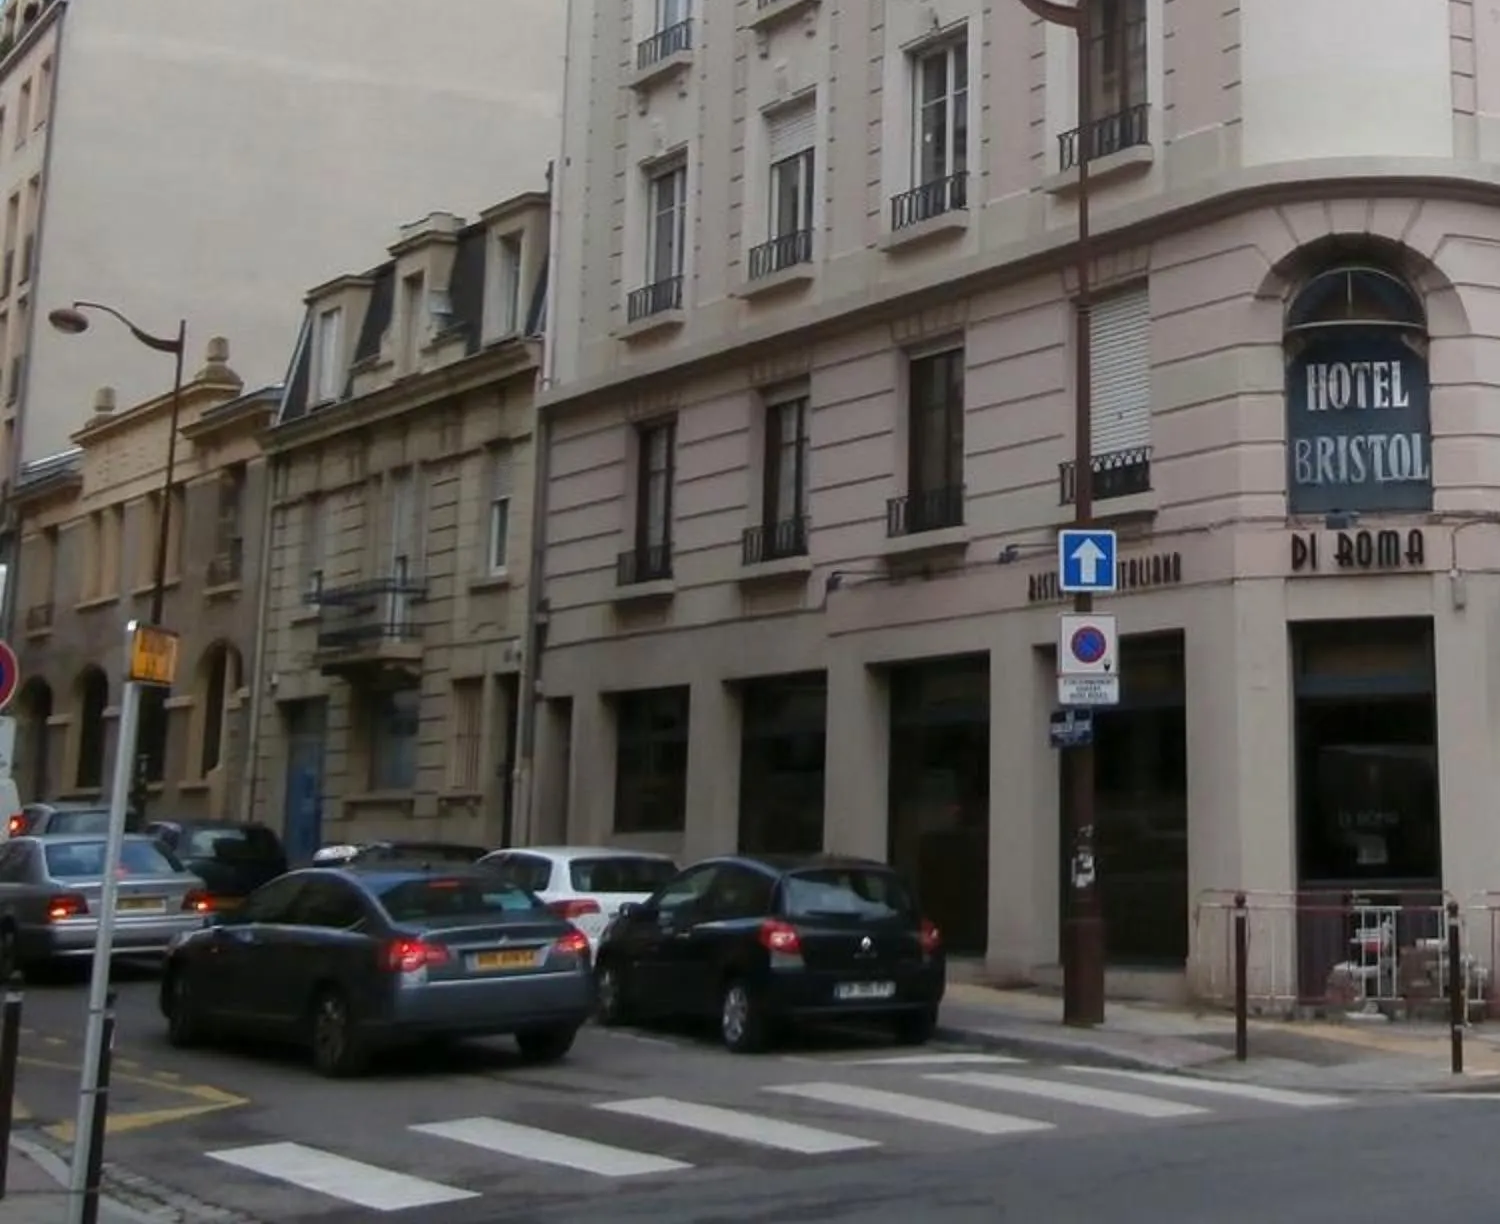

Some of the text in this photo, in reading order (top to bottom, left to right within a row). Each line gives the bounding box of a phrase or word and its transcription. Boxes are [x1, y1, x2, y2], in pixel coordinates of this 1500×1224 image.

[1306, 360, 1410, 412] HOTEL
[1295, 432, 1430, 485] BRISTOL
[1291, 528, 1425, 573] DI ROMA
